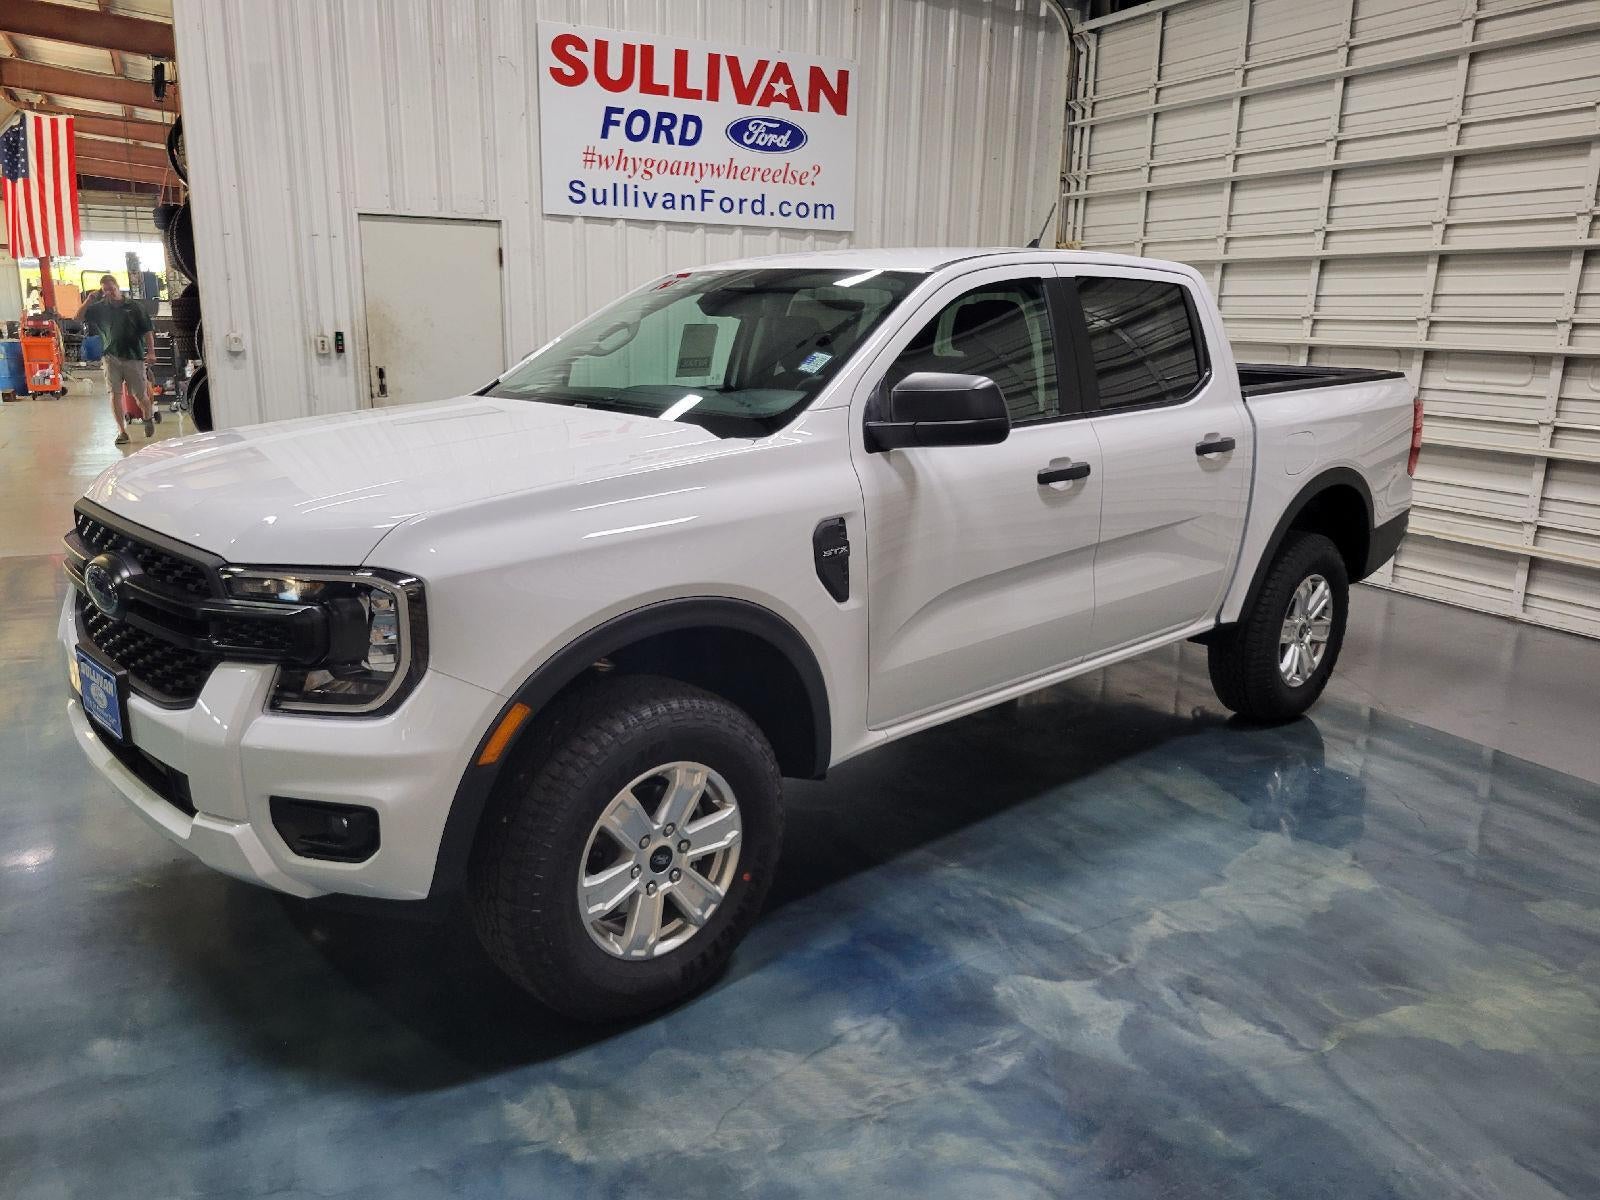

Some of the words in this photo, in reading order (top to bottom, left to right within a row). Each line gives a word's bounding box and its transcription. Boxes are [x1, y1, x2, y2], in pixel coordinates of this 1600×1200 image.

[549, 33, 850, 116] SULLIVAN
[600, 105, 703, 147] FORD
[743, 120, 792, 148] Ford
[582, 145, 821, 187] #whygoanywhereelse?
[568, 179, 835, 220] SullivanFord.com
[822, 545, 848, 556] STX
